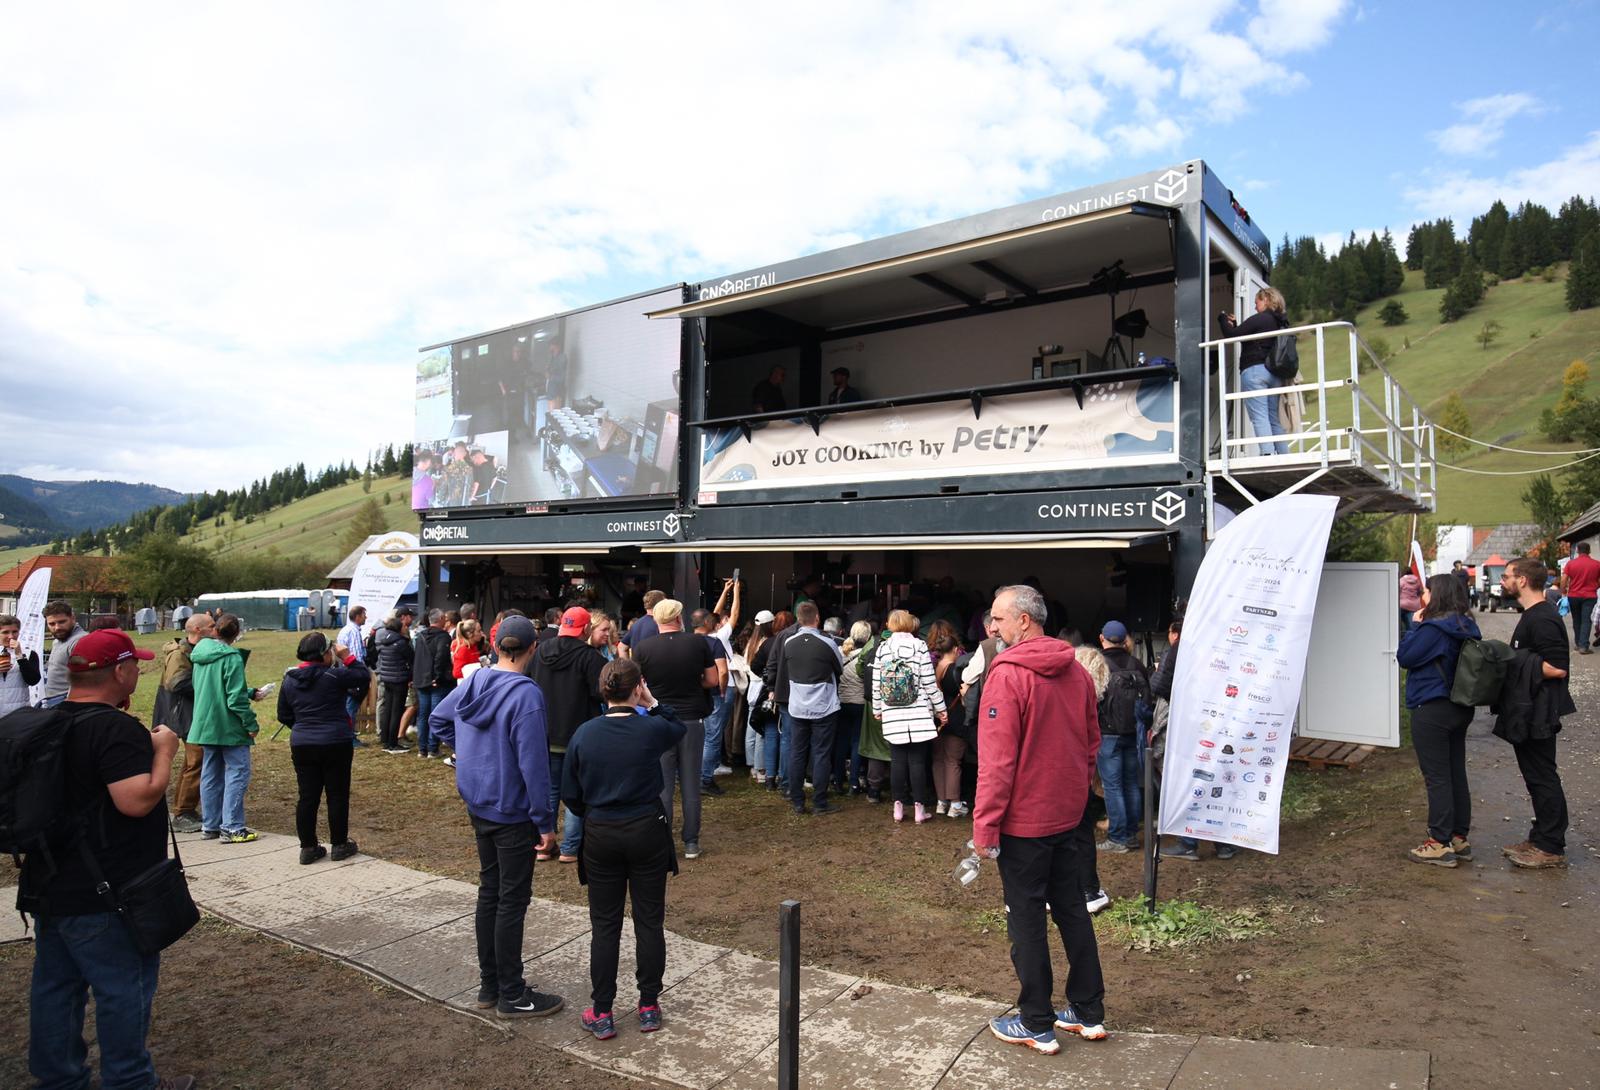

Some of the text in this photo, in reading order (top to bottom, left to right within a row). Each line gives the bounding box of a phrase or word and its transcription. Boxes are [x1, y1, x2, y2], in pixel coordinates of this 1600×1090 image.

[1042, 185, 1149, 222] CONTINEST
[772, 448, 808, 467] JOY
[815, 440, 913, 464] COOKING
[920, 439, 945, 460] by
[1038, 502, 1147, 518] CONTINEST
[607, 520, 661, 533] CONTINEST
